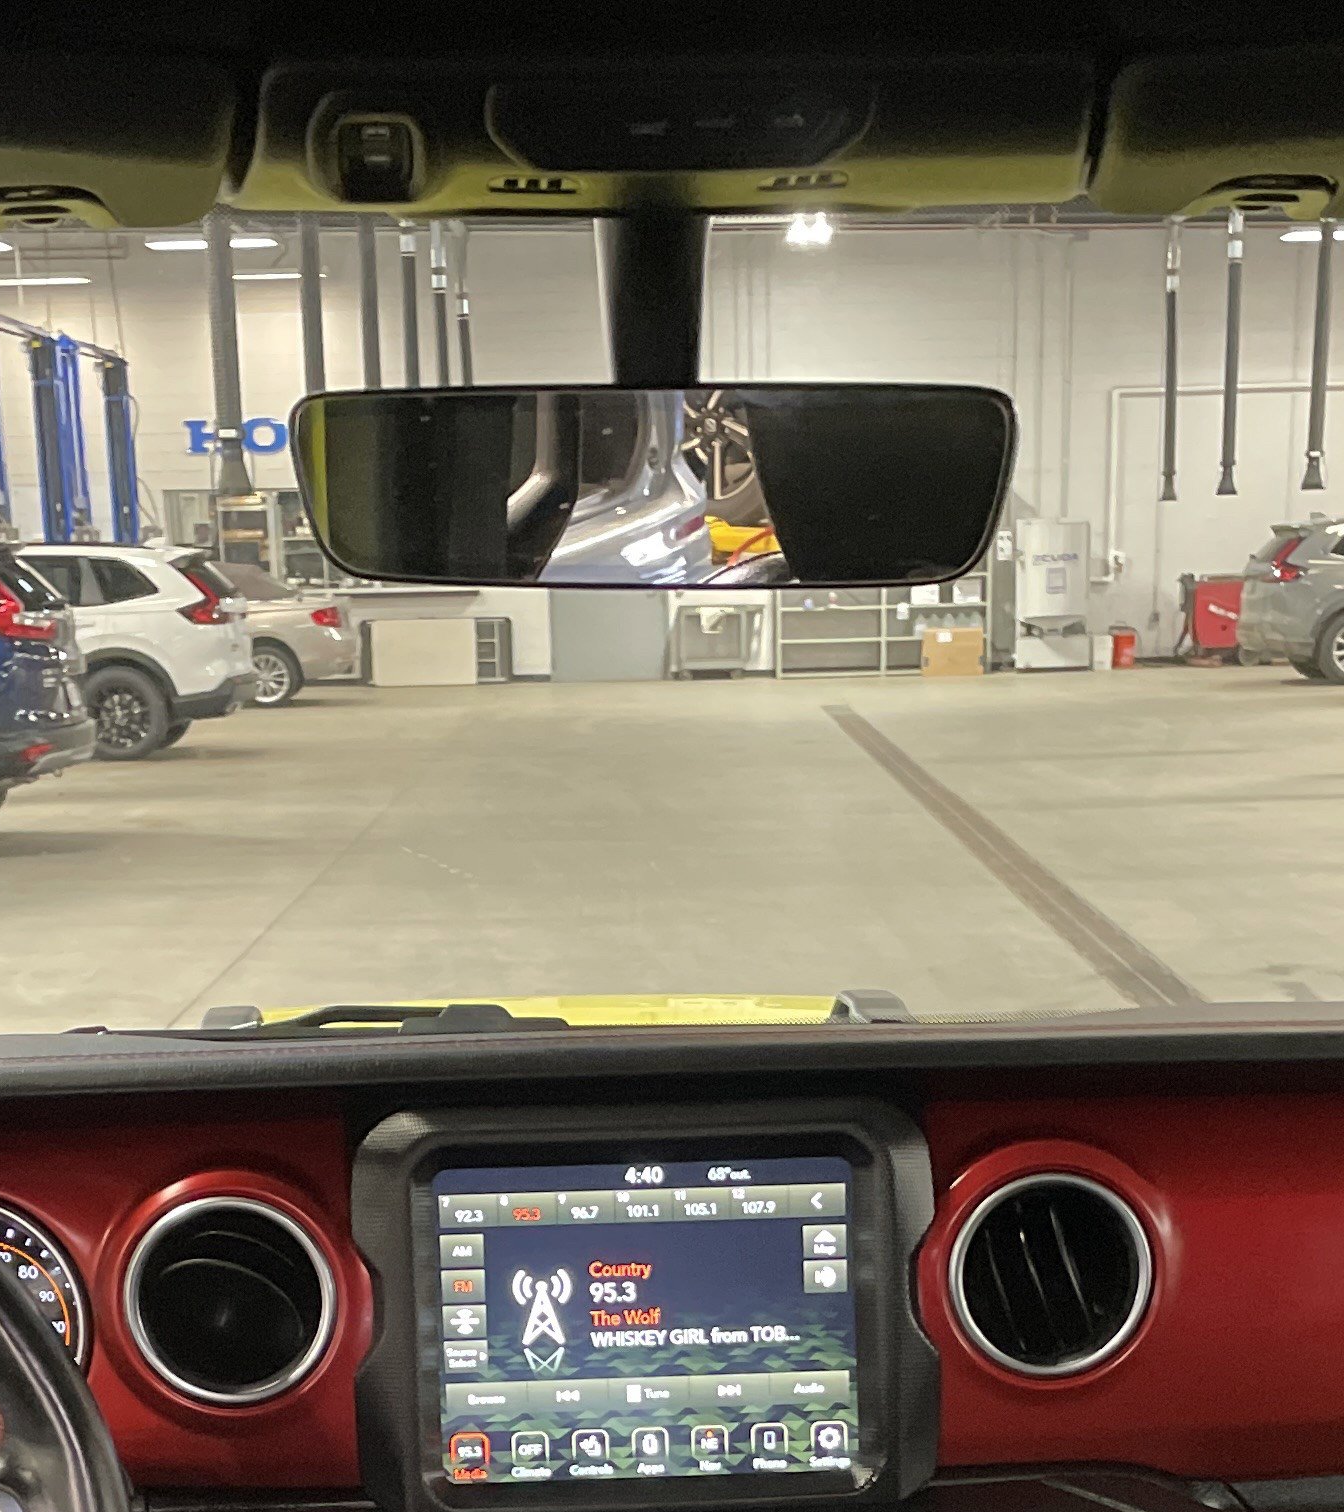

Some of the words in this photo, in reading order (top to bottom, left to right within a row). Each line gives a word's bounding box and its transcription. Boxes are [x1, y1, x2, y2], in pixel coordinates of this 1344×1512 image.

[624, 1165, 664, 1184] 4:40
[512, 1207, 541, 1221] 95.3
[570, 1205, 599, 1219] 96.7
[626, 1204, 660, 1217] 101.1
[684, 1202, 717, 1215] 105.1
[741, 1200, 776, 1214] 107.9
[454, 1209, 484, 1222] 92.3
[451, 1245, 473, 1257] AM
[17, 1264, 39, 1280] 80
[588, 1260, 653, 1280] Country
[452, 1279, 474, 1293] FM
[588, 1281, 638, 1304] 95.3
[38, 1290, 55, 1304] 90
[589, 1309, 621, 1327] The
[623, 1306, 662, 1326] Wolf
[589, 1328, 668, 1348] WHISKEY
[669, 1327, 709, 1345] GIRL
[710, 1326, 749, 1344] from
[749, 1324, 801, 1342] TOB...
[643, 1388, 670, 1399] Tune
[793, 1382, 825, 1394] Audio
[517, 1443, 543, 1456] OFF
[636, 1462, 666, 1475] Apps
[752, 1457, 788, 1470] Phone
